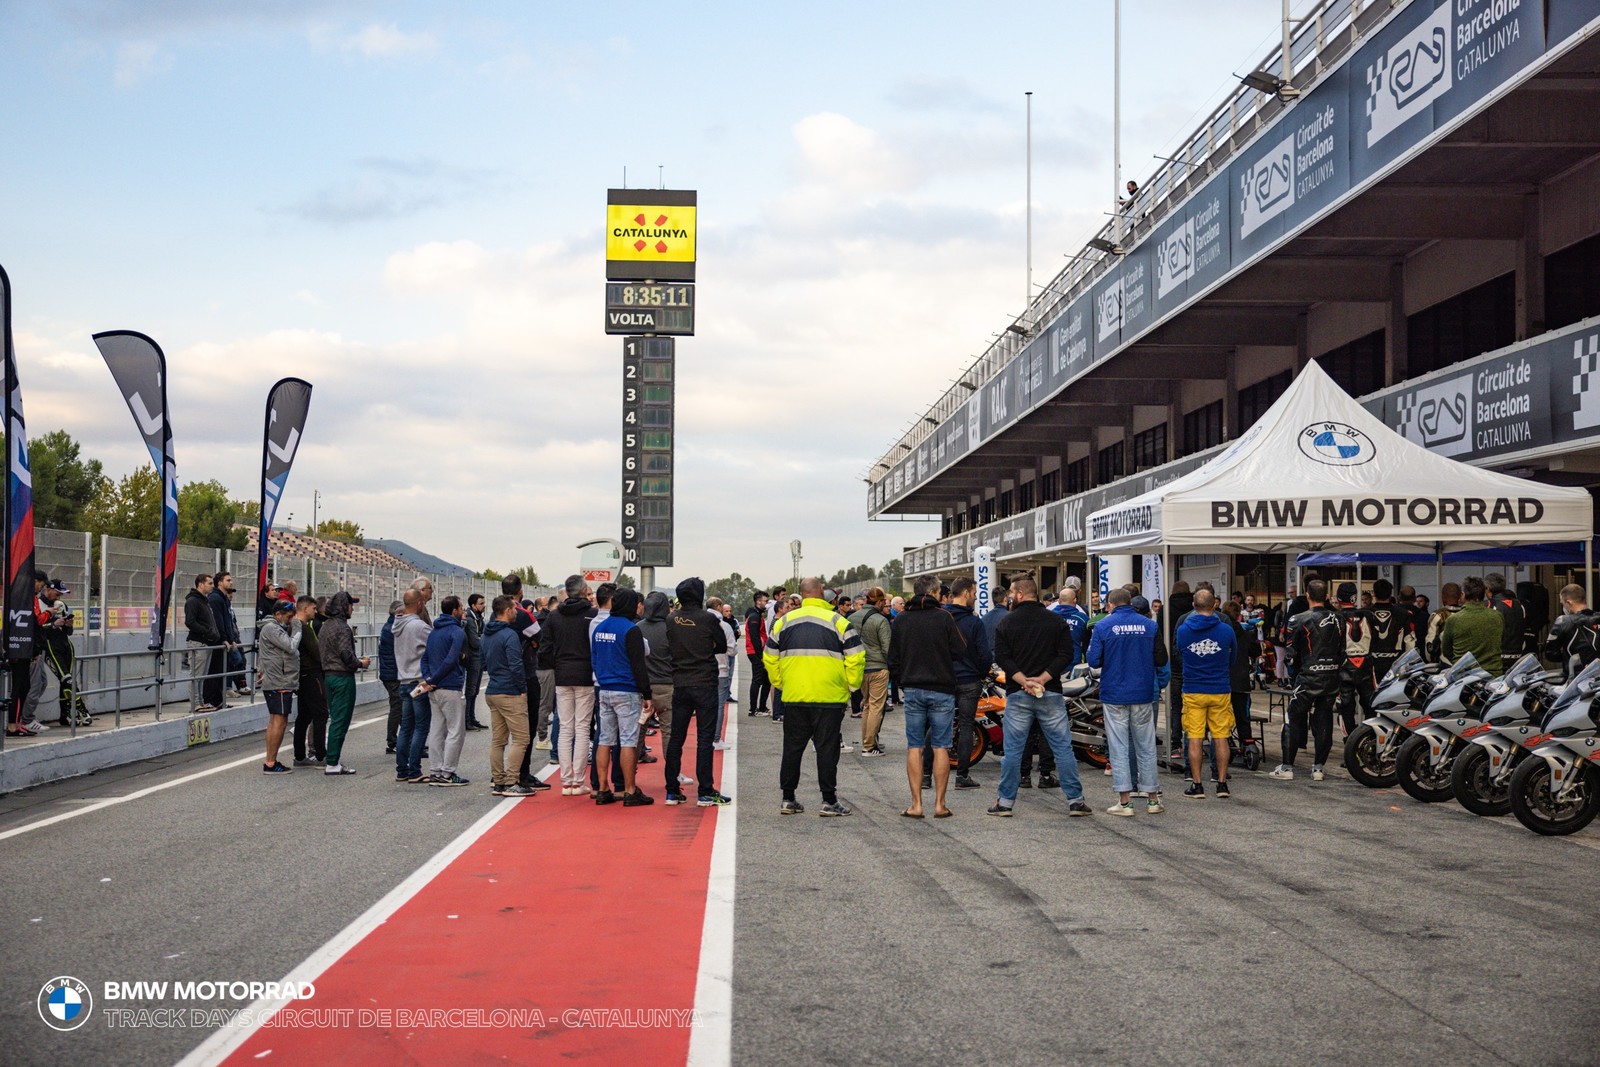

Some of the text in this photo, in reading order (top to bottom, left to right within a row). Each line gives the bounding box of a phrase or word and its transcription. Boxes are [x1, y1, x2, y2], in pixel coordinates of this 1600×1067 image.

[1457, 18, 1520, 80] CATALUNYA
[1297, 104, 1334, 149] Circuit de
[1297, 135, 1334, 176] Barcelona
[1297, 159, 1335, 199] CATALUNYA
[613, 228, 688, 238] CATALUNYA
[623, 287, 688, 306] 8:35:11
[609, 313, 655, 326] VOLTA
[627, 343, 635, 355] 1
[626, 366, 636, 378] 2
[1477, 358, 1530, 395] Circuit de
[626, 389, 636, 401] 3
[1477, 393, 1530, 424] Barcelona
[625, 412, 636, 424] 4
[626, 435, 636, 447] 5
[1477, 421, 1531, 450] CATALUNYA
[626, 457, 636, 470] 6
[625, 481, 635, 493] 7
[625, 503, 635, 516] 8
[1211, 498, 1544, 528] BMW MOTORRAD
[1063, 499, 1083, 542] RACC
[1110, 505, 1152, 537] MOTORRAD
[625, 526, 635, 538] 9
[625, 549, 636, 562] 10
